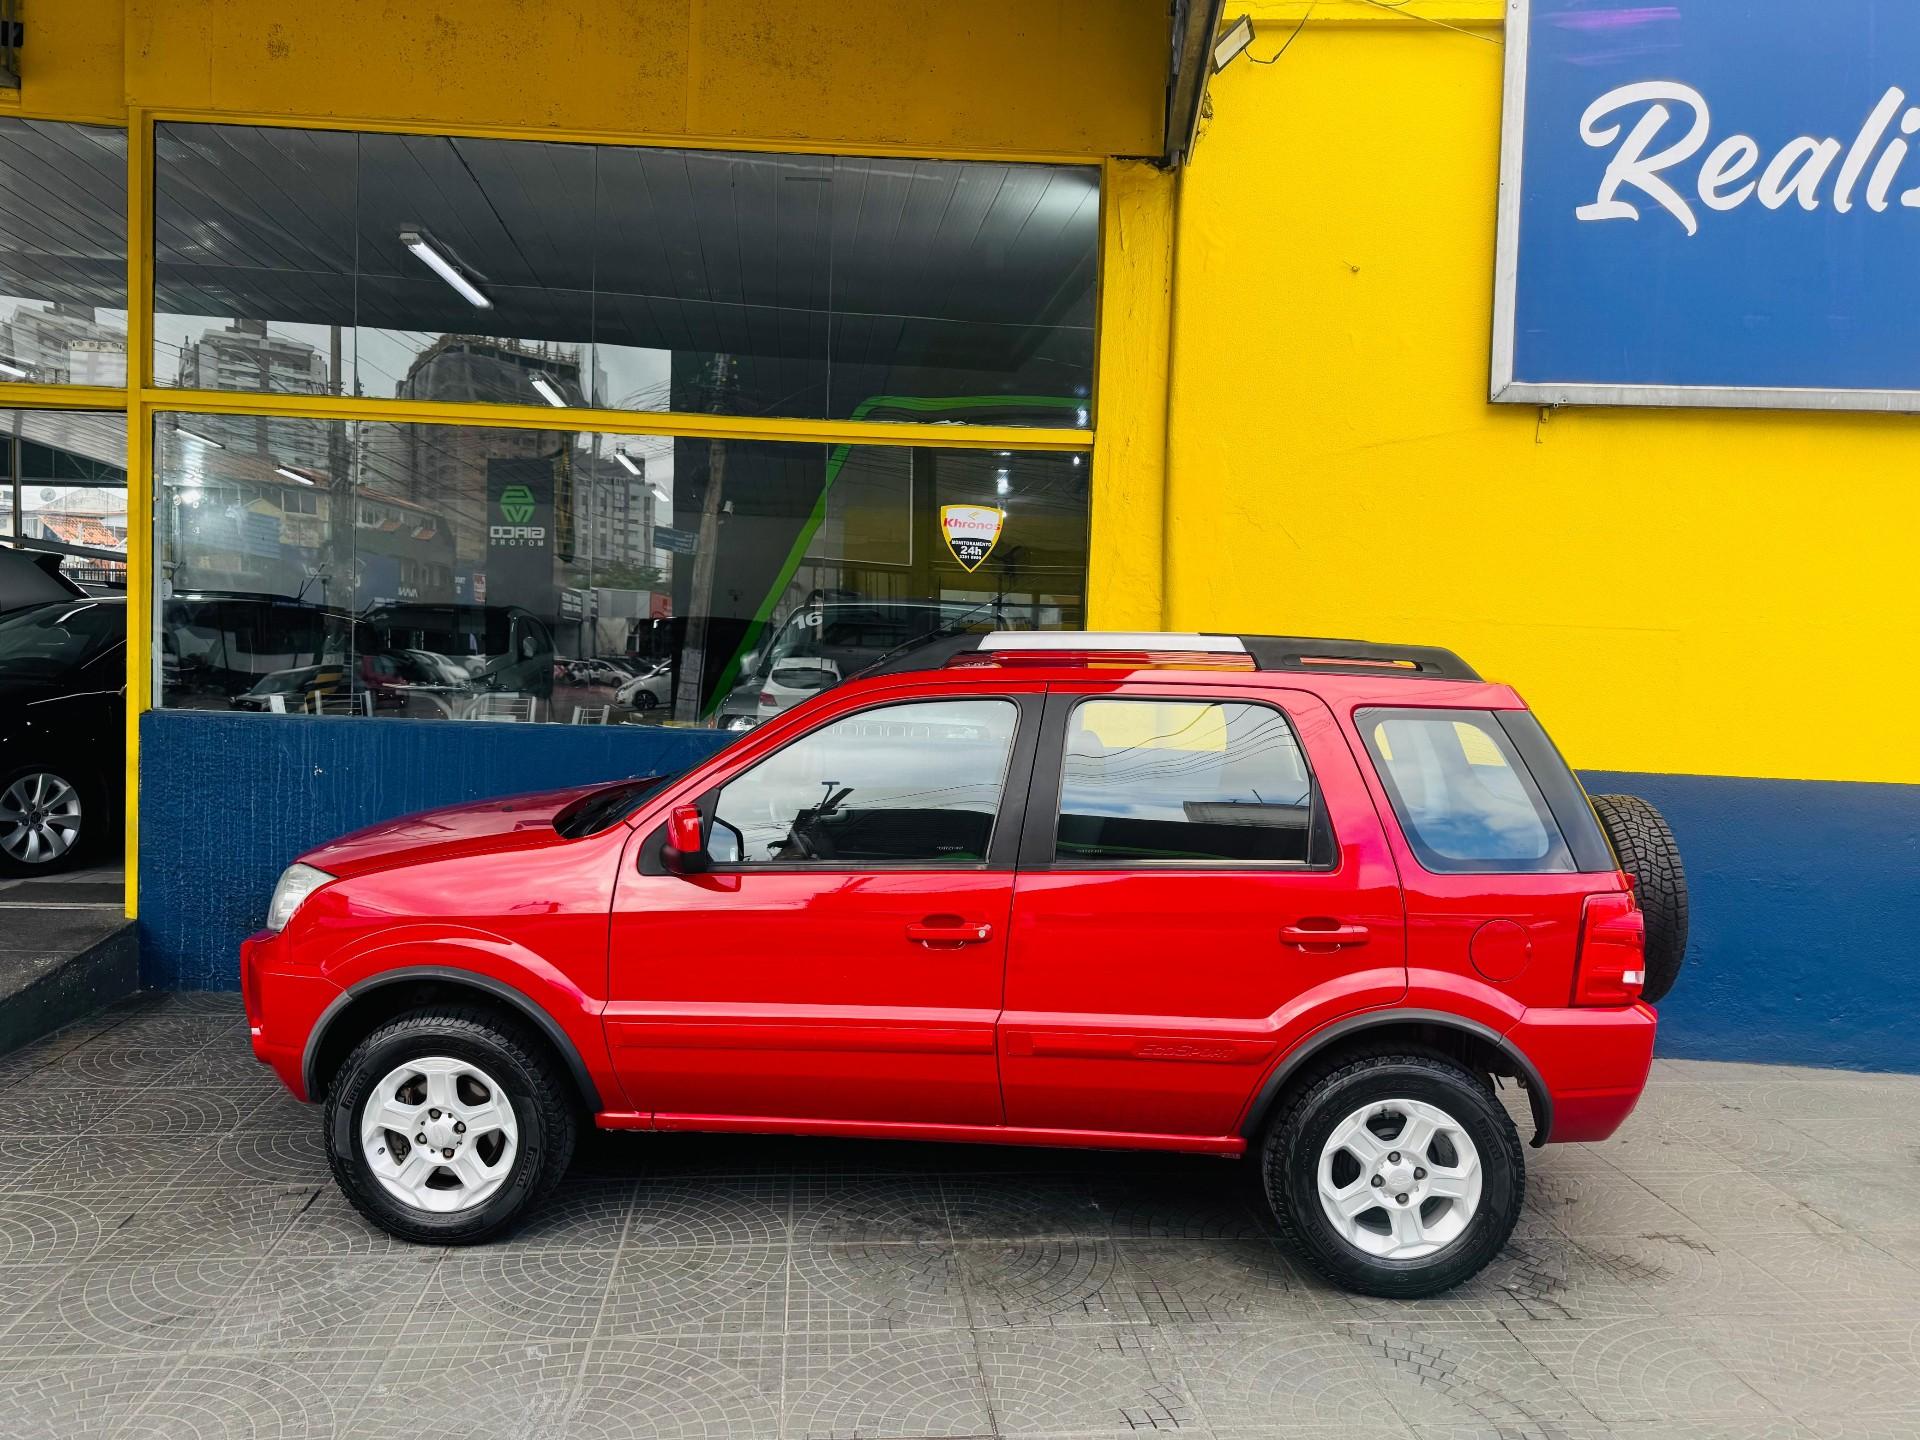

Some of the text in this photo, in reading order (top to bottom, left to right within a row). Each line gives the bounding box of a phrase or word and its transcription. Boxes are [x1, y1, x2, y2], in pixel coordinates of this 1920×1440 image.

[943, 517, 1001, 531] Khronos
[951, 539, 992, 547] MONITORAMENTO
[960, 545, 982, 556] 24h
